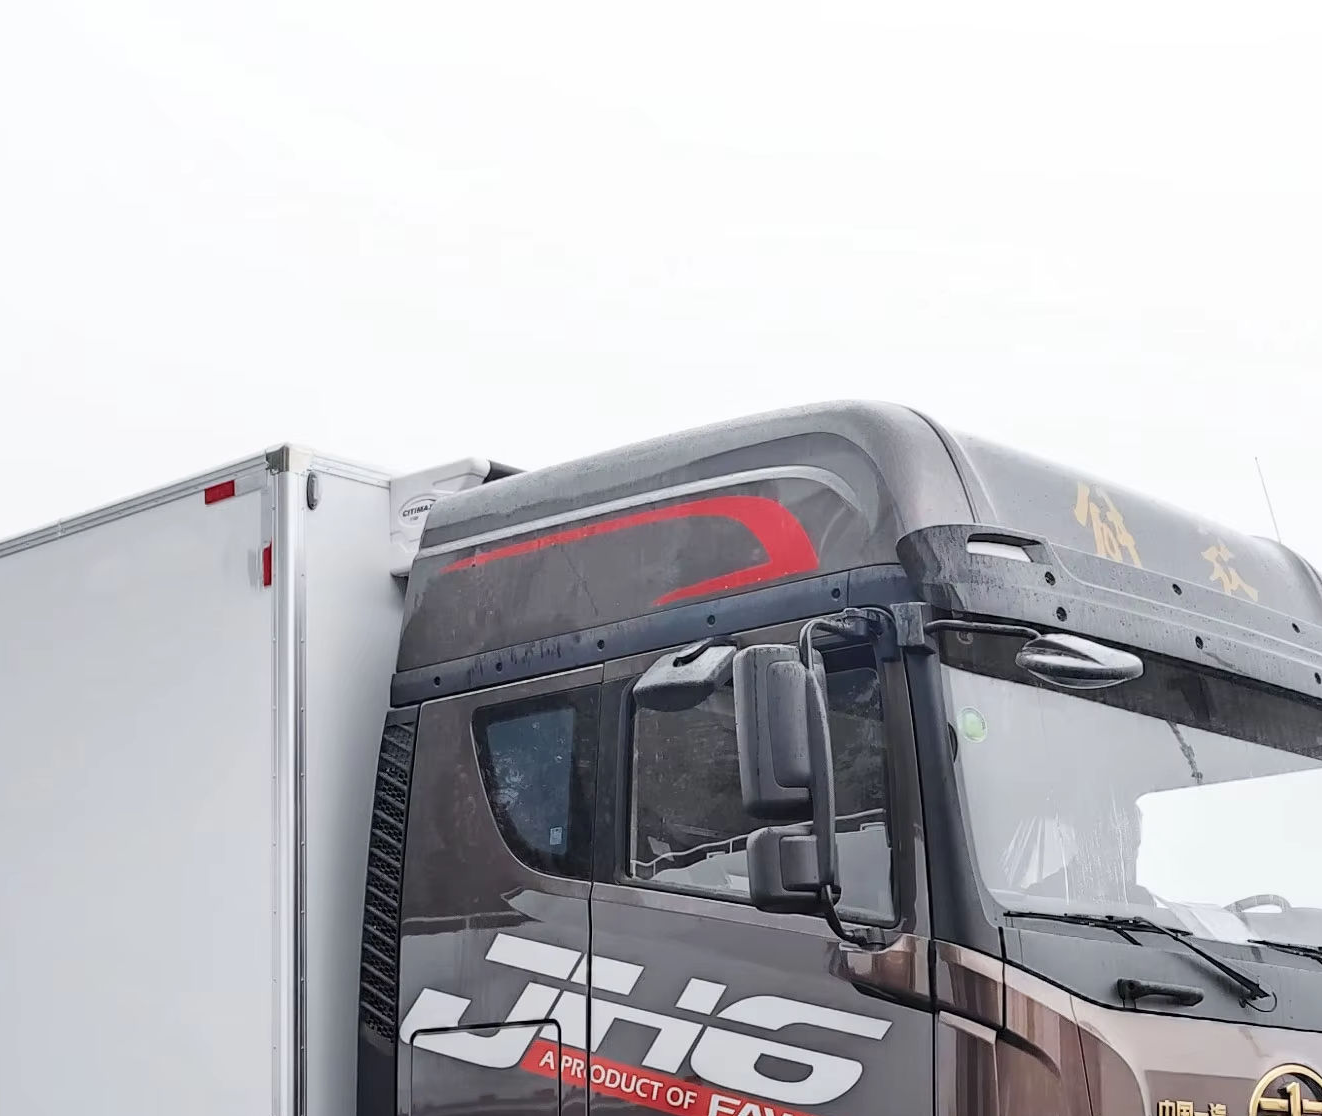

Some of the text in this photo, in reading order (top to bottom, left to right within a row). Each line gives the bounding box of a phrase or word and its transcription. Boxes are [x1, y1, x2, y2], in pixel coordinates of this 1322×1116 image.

[399, 932, 893, 1106] JH6
[538, 1050, 555, 1070] A
[560, 1056, 664, 1102] PRODUCT
[665, 1086, 698, 1111] OF
